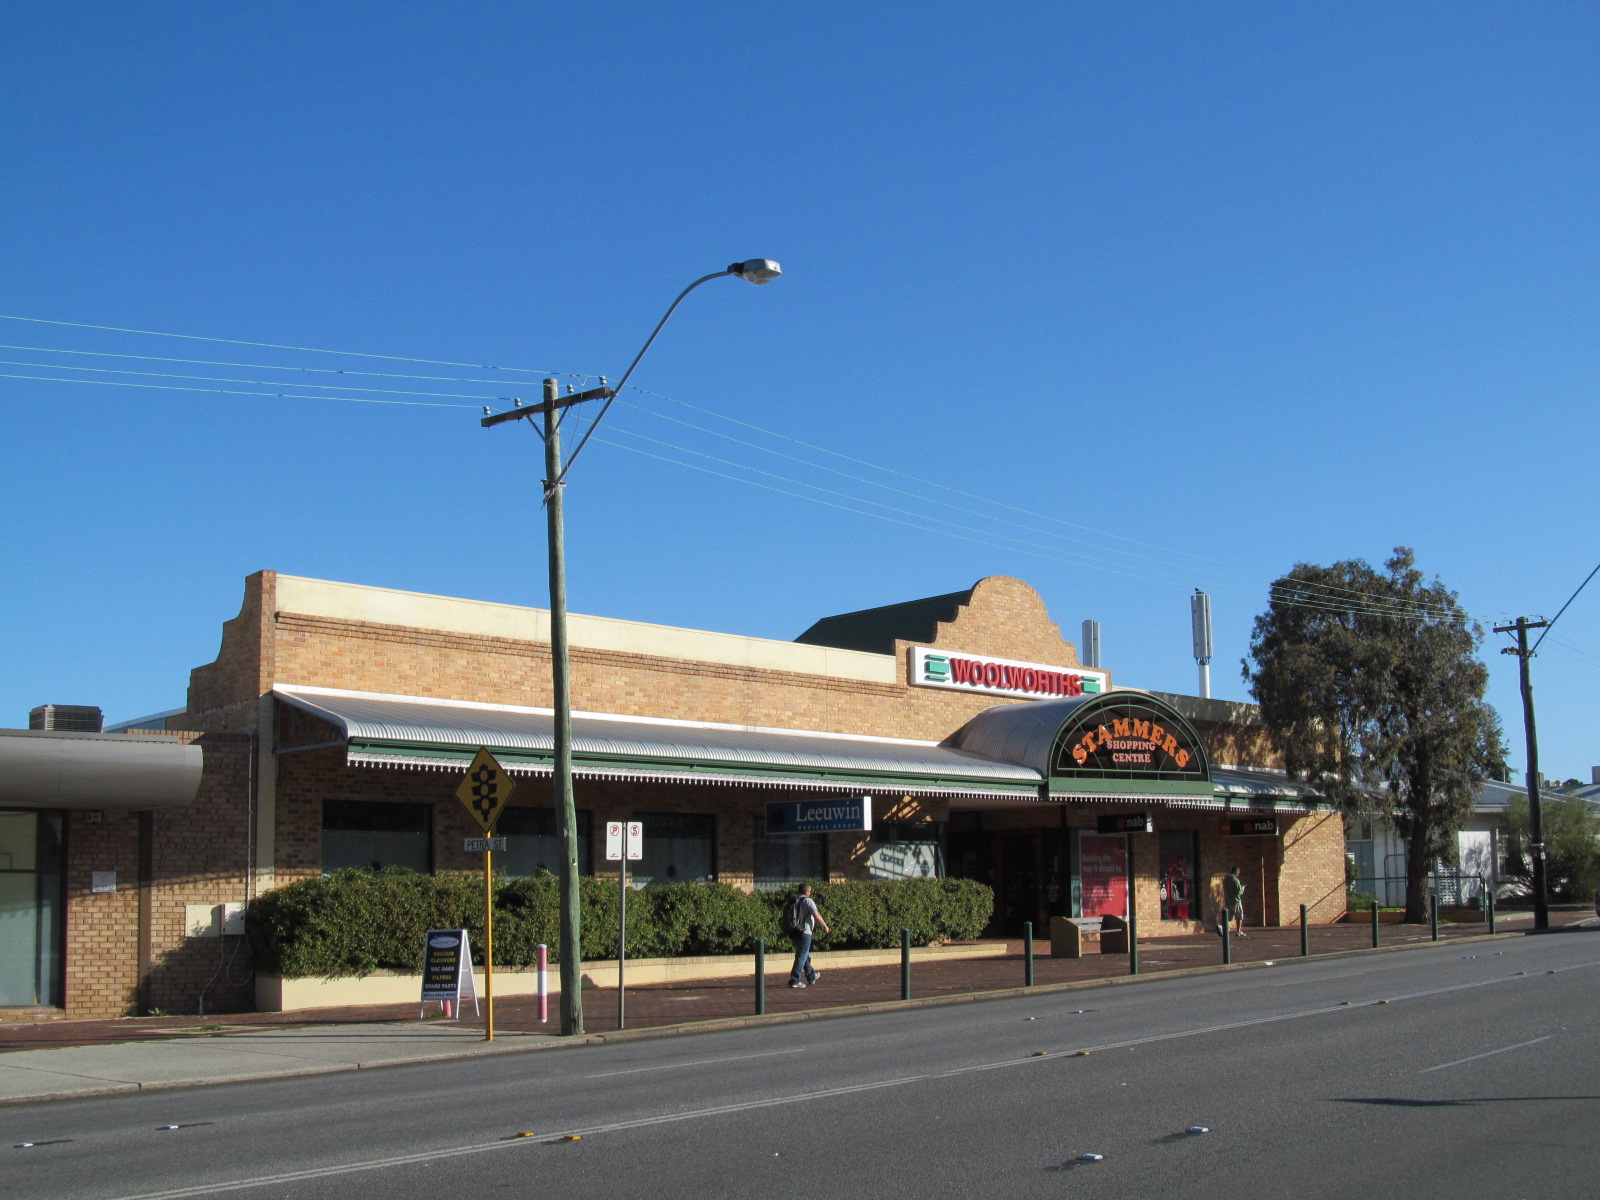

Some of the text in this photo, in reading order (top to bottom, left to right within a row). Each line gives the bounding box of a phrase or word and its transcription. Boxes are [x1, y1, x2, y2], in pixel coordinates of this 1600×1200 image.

[949, 657, 1082, 696] WOOLWORTHS
[1072, 718, 1191, 768] STAMMERS
[1106, 740, 1156, 752] SHOPPING
[1112, 753, 1151, 763] CENTRE
[795, 801, 861, 822] Leeuwin
[1126, 817, 1144, 828] nab
[1254, 820, 1274, 831] nab
[467, 839, 503, 850] PETRA ST
